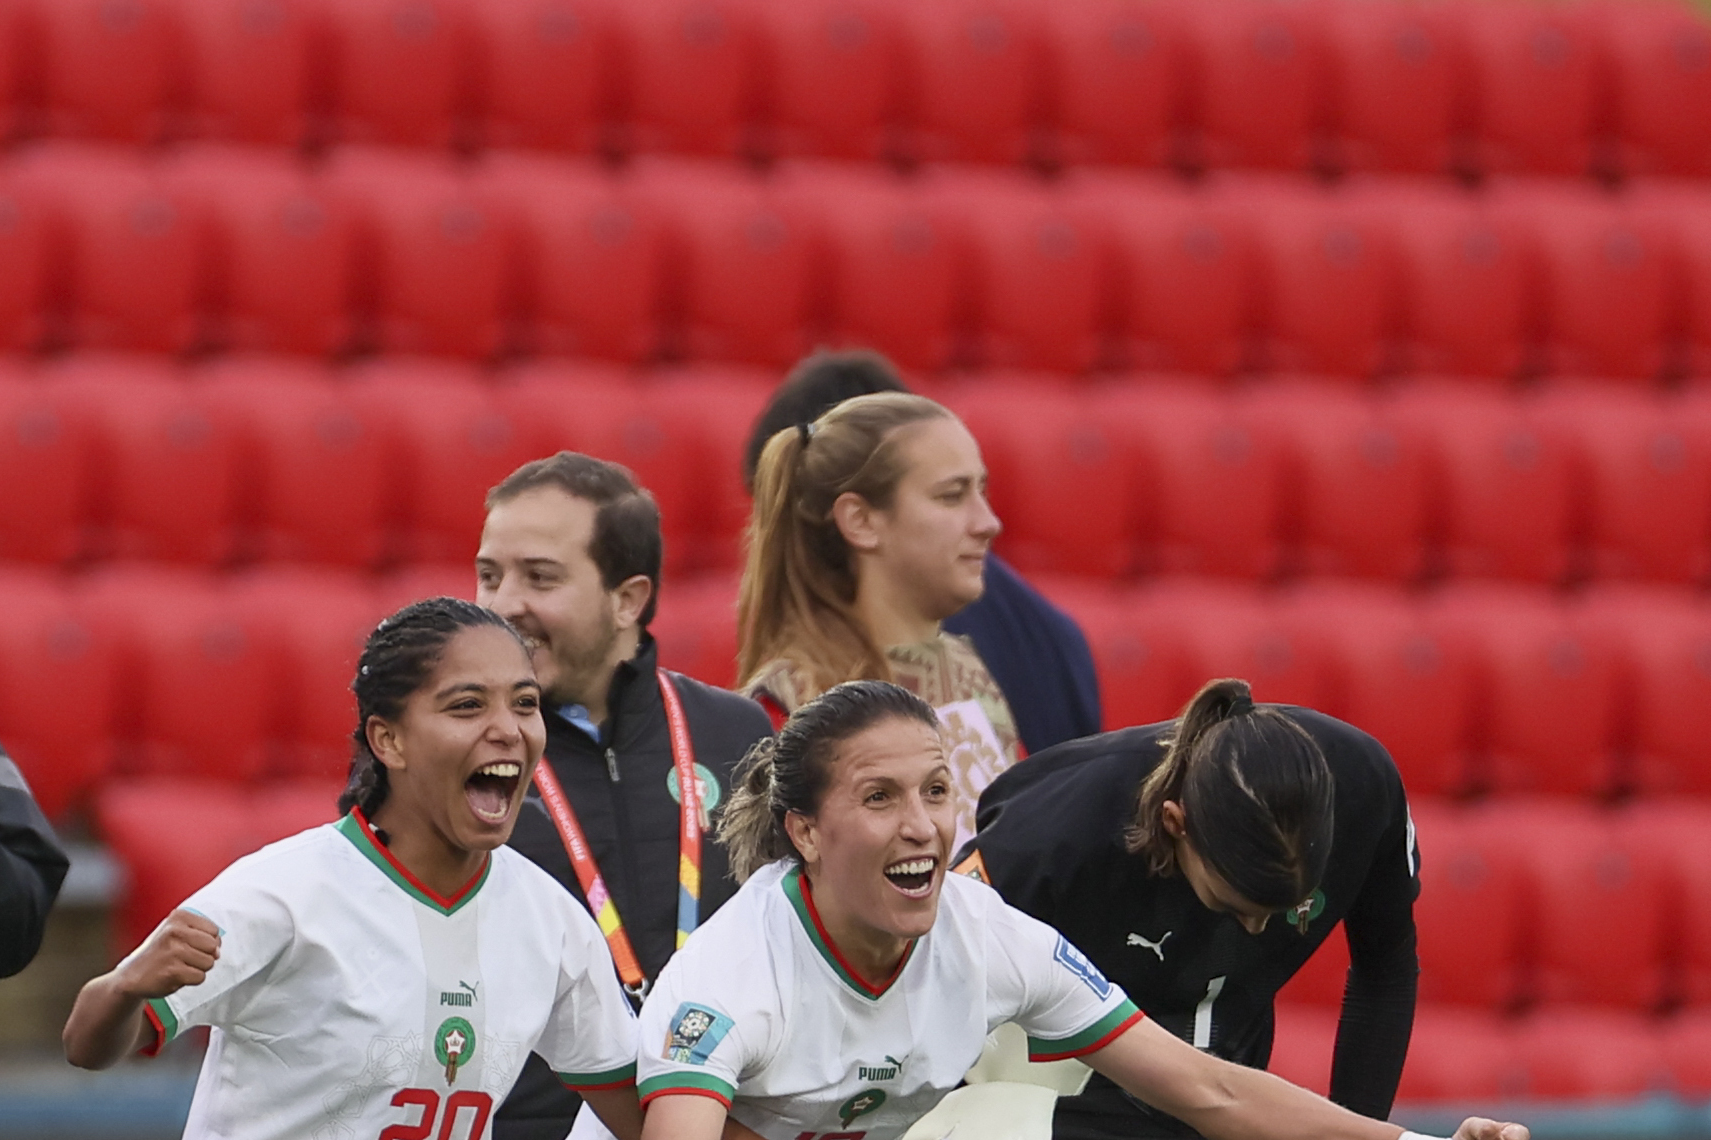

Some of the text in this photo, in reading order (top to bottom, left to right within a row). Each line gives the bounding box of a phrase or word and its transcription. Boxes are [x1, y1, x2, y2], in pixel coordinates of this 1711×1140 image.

[547, 794, 576, 840] WOMEN'S
[567, 837, 585, 861] FIFA
[440, 992, 473, 1007] PUMA
[1193, 976, 1227, 1048] 1
[858, 1066, 896, 1082] PUMA
